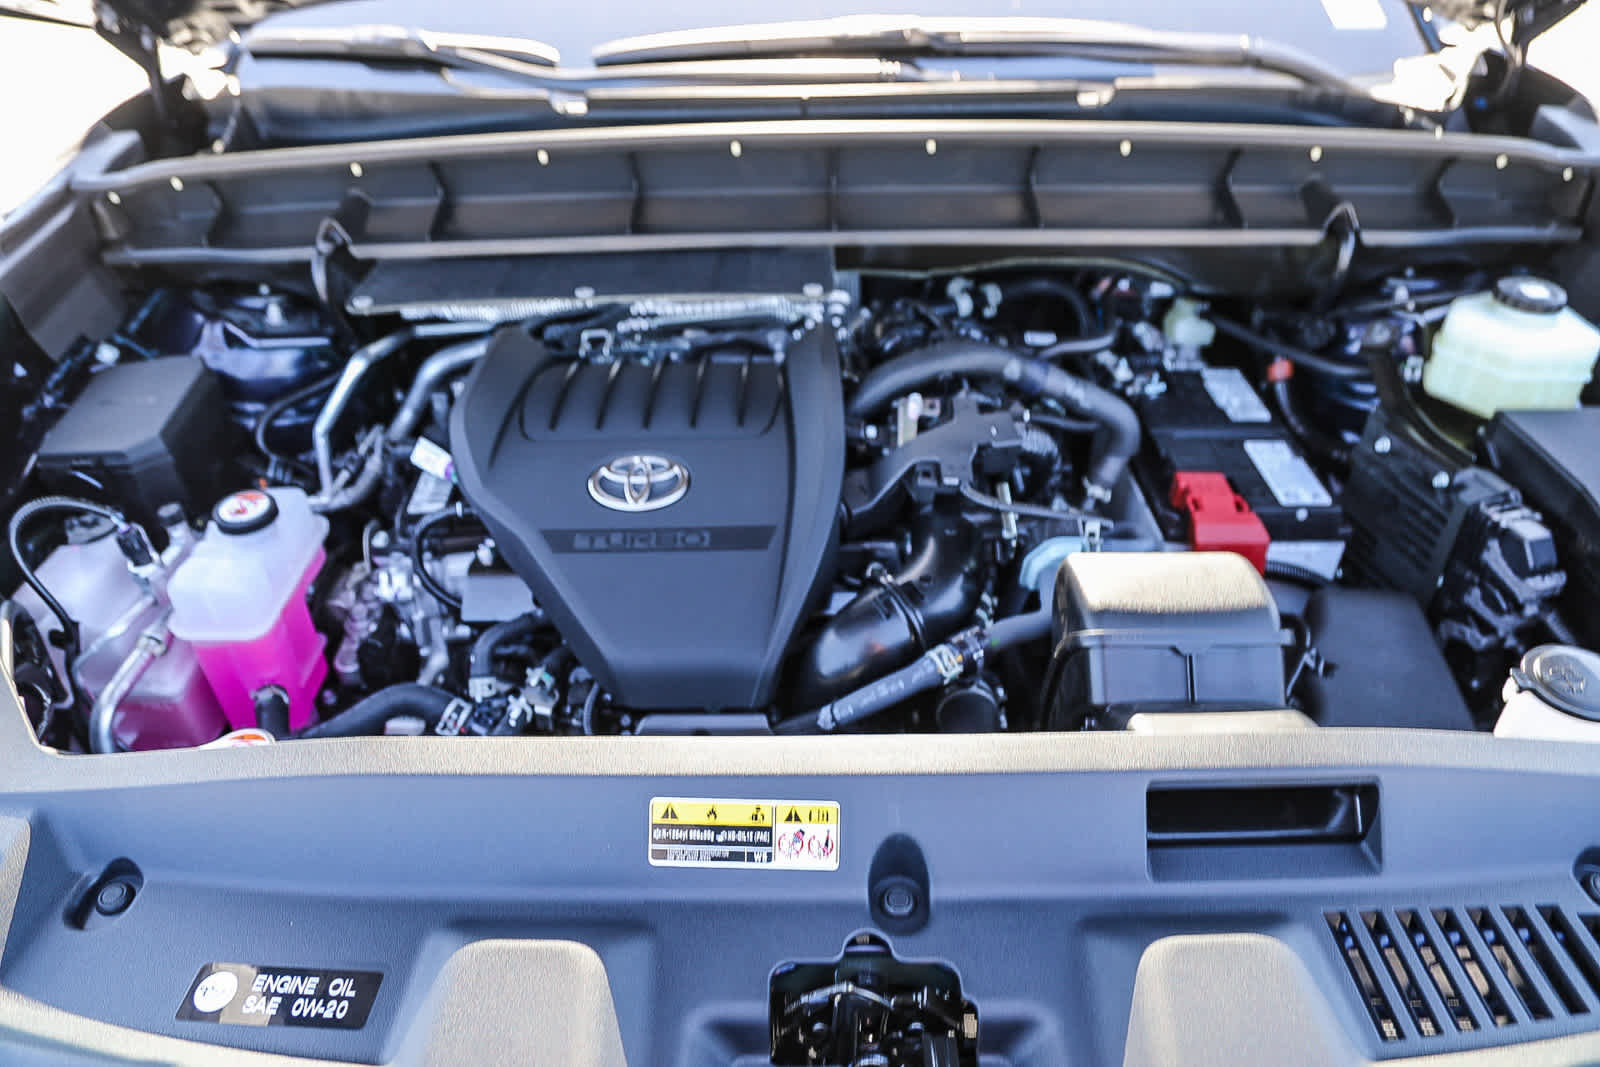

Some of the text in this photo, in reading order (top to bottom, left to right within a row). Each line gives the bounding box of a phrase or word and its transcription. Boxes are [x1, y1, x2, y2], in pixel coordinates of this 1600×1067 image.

[252, 973, 357, 998] ENGINE OIL
[241, 995, 349, 1020] SAE 0W-20
